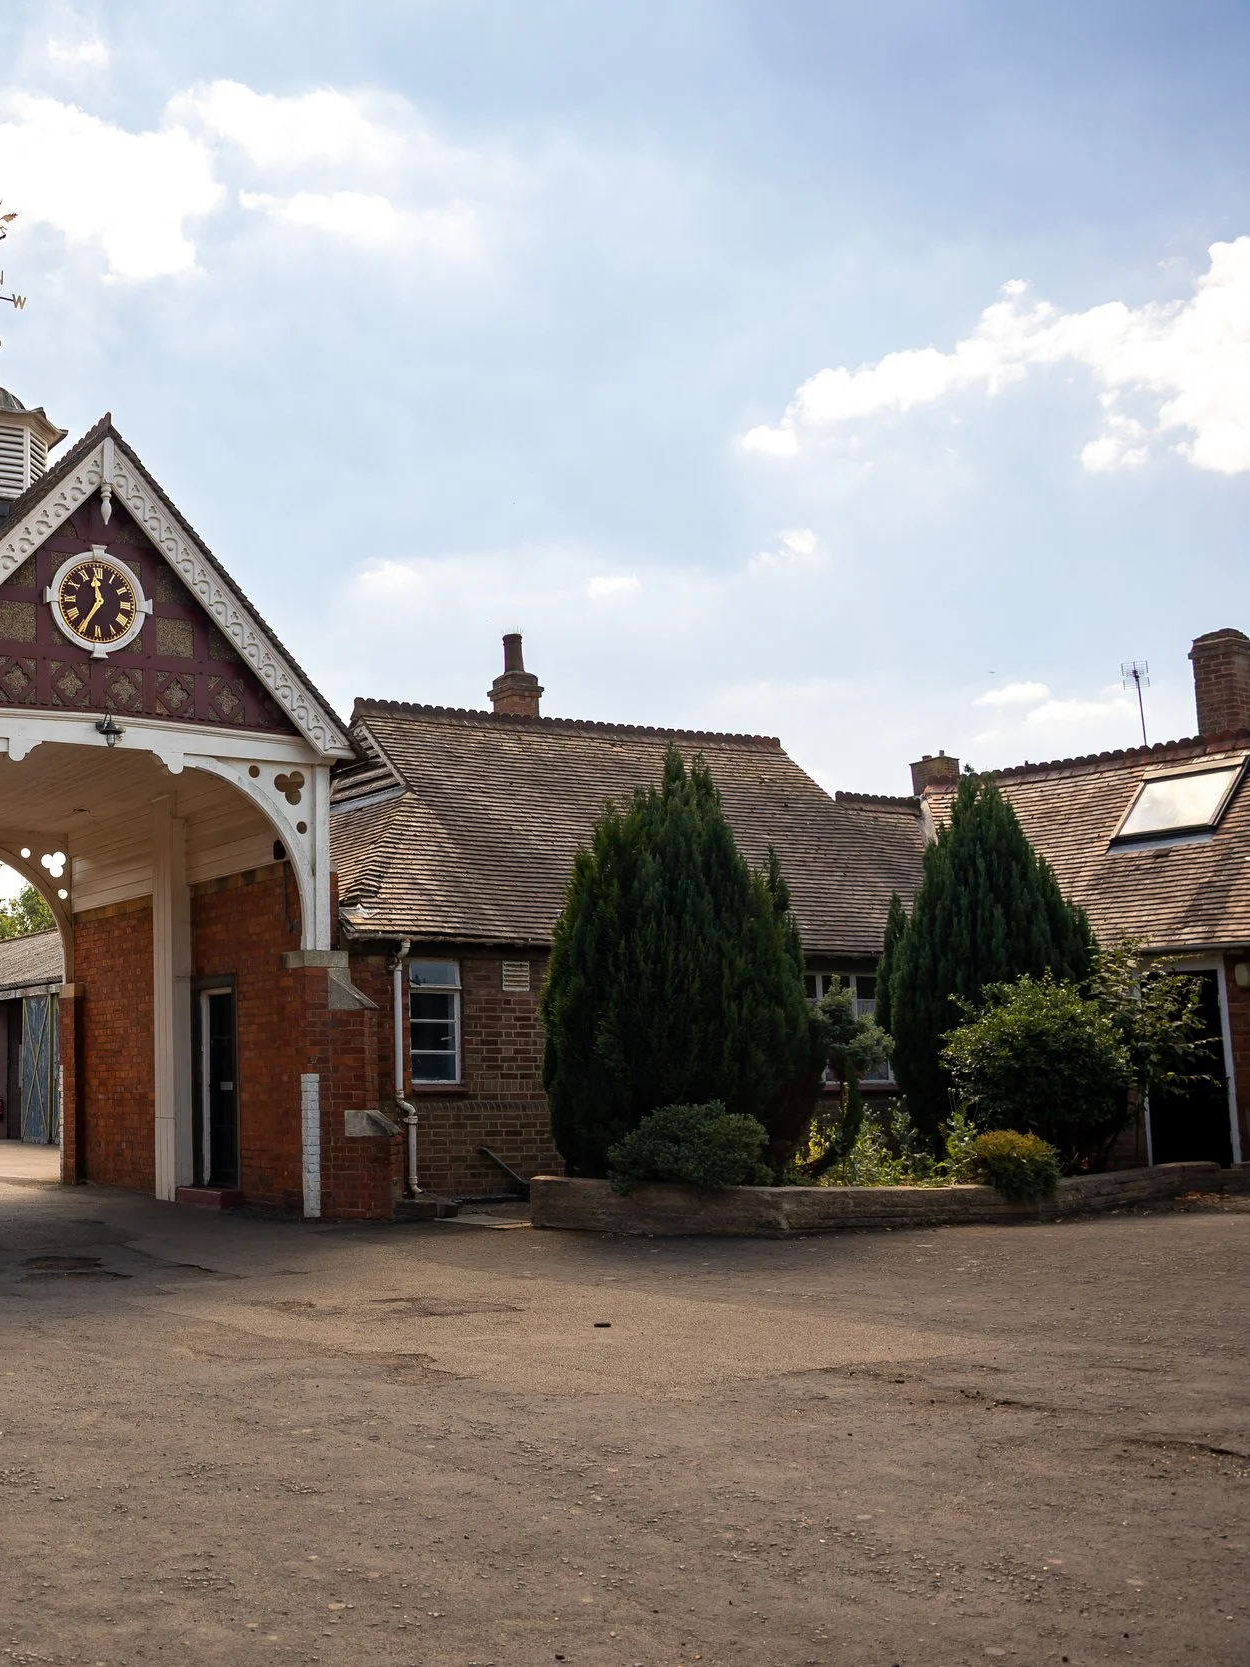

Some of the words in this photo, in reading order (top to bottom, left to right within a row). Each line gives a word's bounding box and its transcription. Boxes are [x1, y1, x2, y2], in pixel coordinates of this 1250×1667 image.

[12, 294, 27, 310] W
[78, 570, 90, 582] XI
[109, 574, 116, 584] I
[68, 580, 80, 590] X
[116, 586, 127, 595] II
[120, 601, 131, 610] III
[109, 624, 116, 635] V
